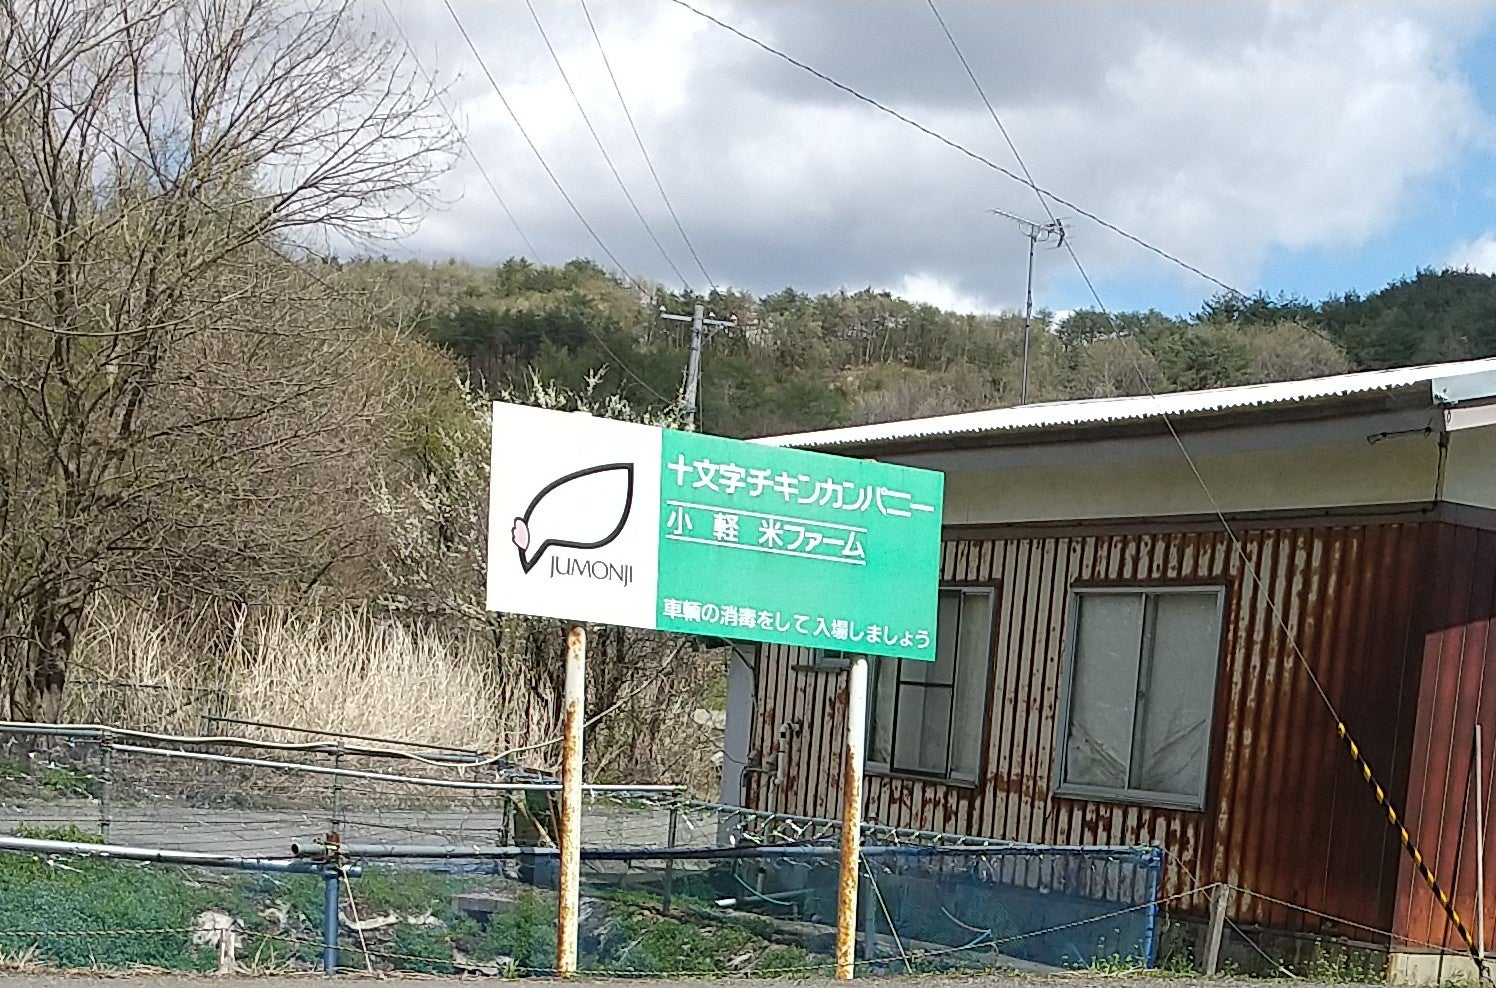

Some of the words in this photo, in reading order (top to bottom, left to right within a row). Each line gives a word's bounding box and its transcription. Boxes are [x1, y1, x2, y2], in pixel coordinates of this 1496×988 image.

[667, 454, 935, 518] 十文字チキンカンパニー
[550, 555, 633, 587] JUMONJI
